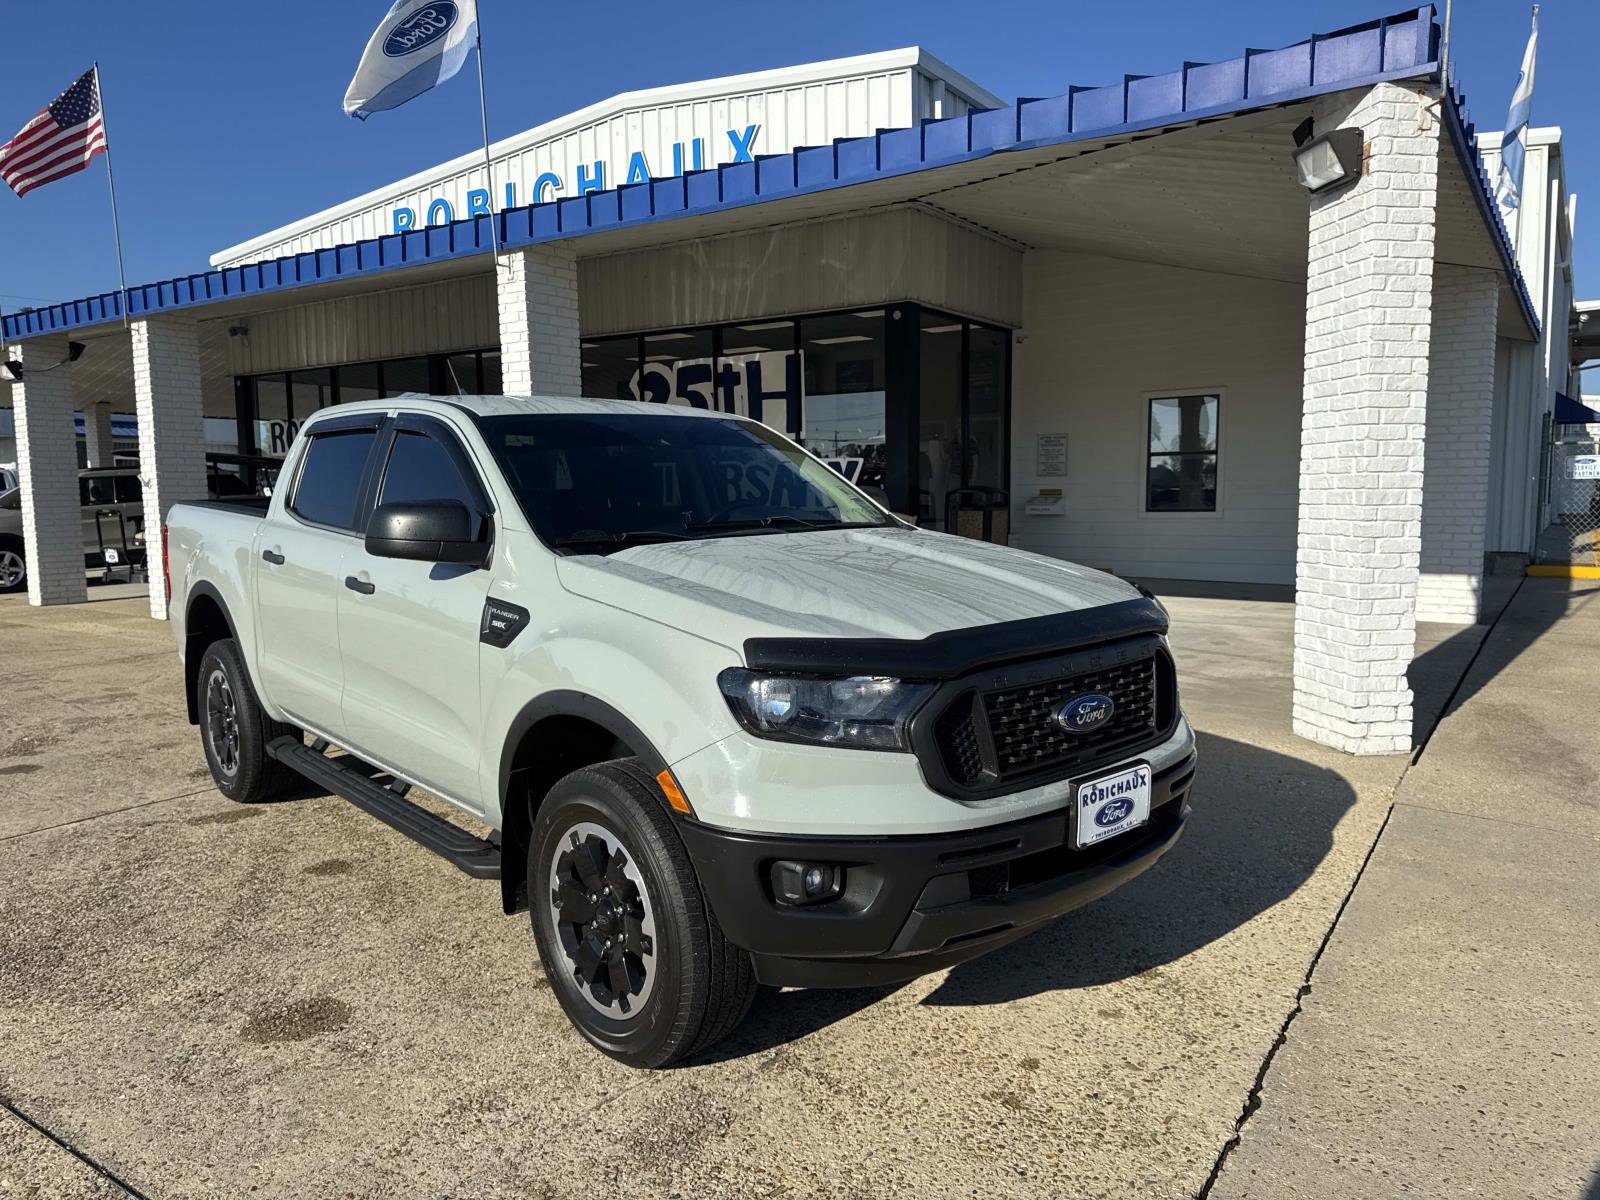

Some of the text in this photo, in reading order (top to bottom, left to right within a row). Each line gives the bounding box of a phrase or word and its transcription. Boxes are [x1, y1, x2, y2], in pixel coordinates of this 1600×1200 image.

[393, 124, 758, 235] ROBICHAUX
[491, 608, 520, 620] RANGER
[1076, 701, 1106, 725] Ford
[1082, 774, 1147, 807] ROBICHAUX
[1102, 801, 1127, 823] Ford
